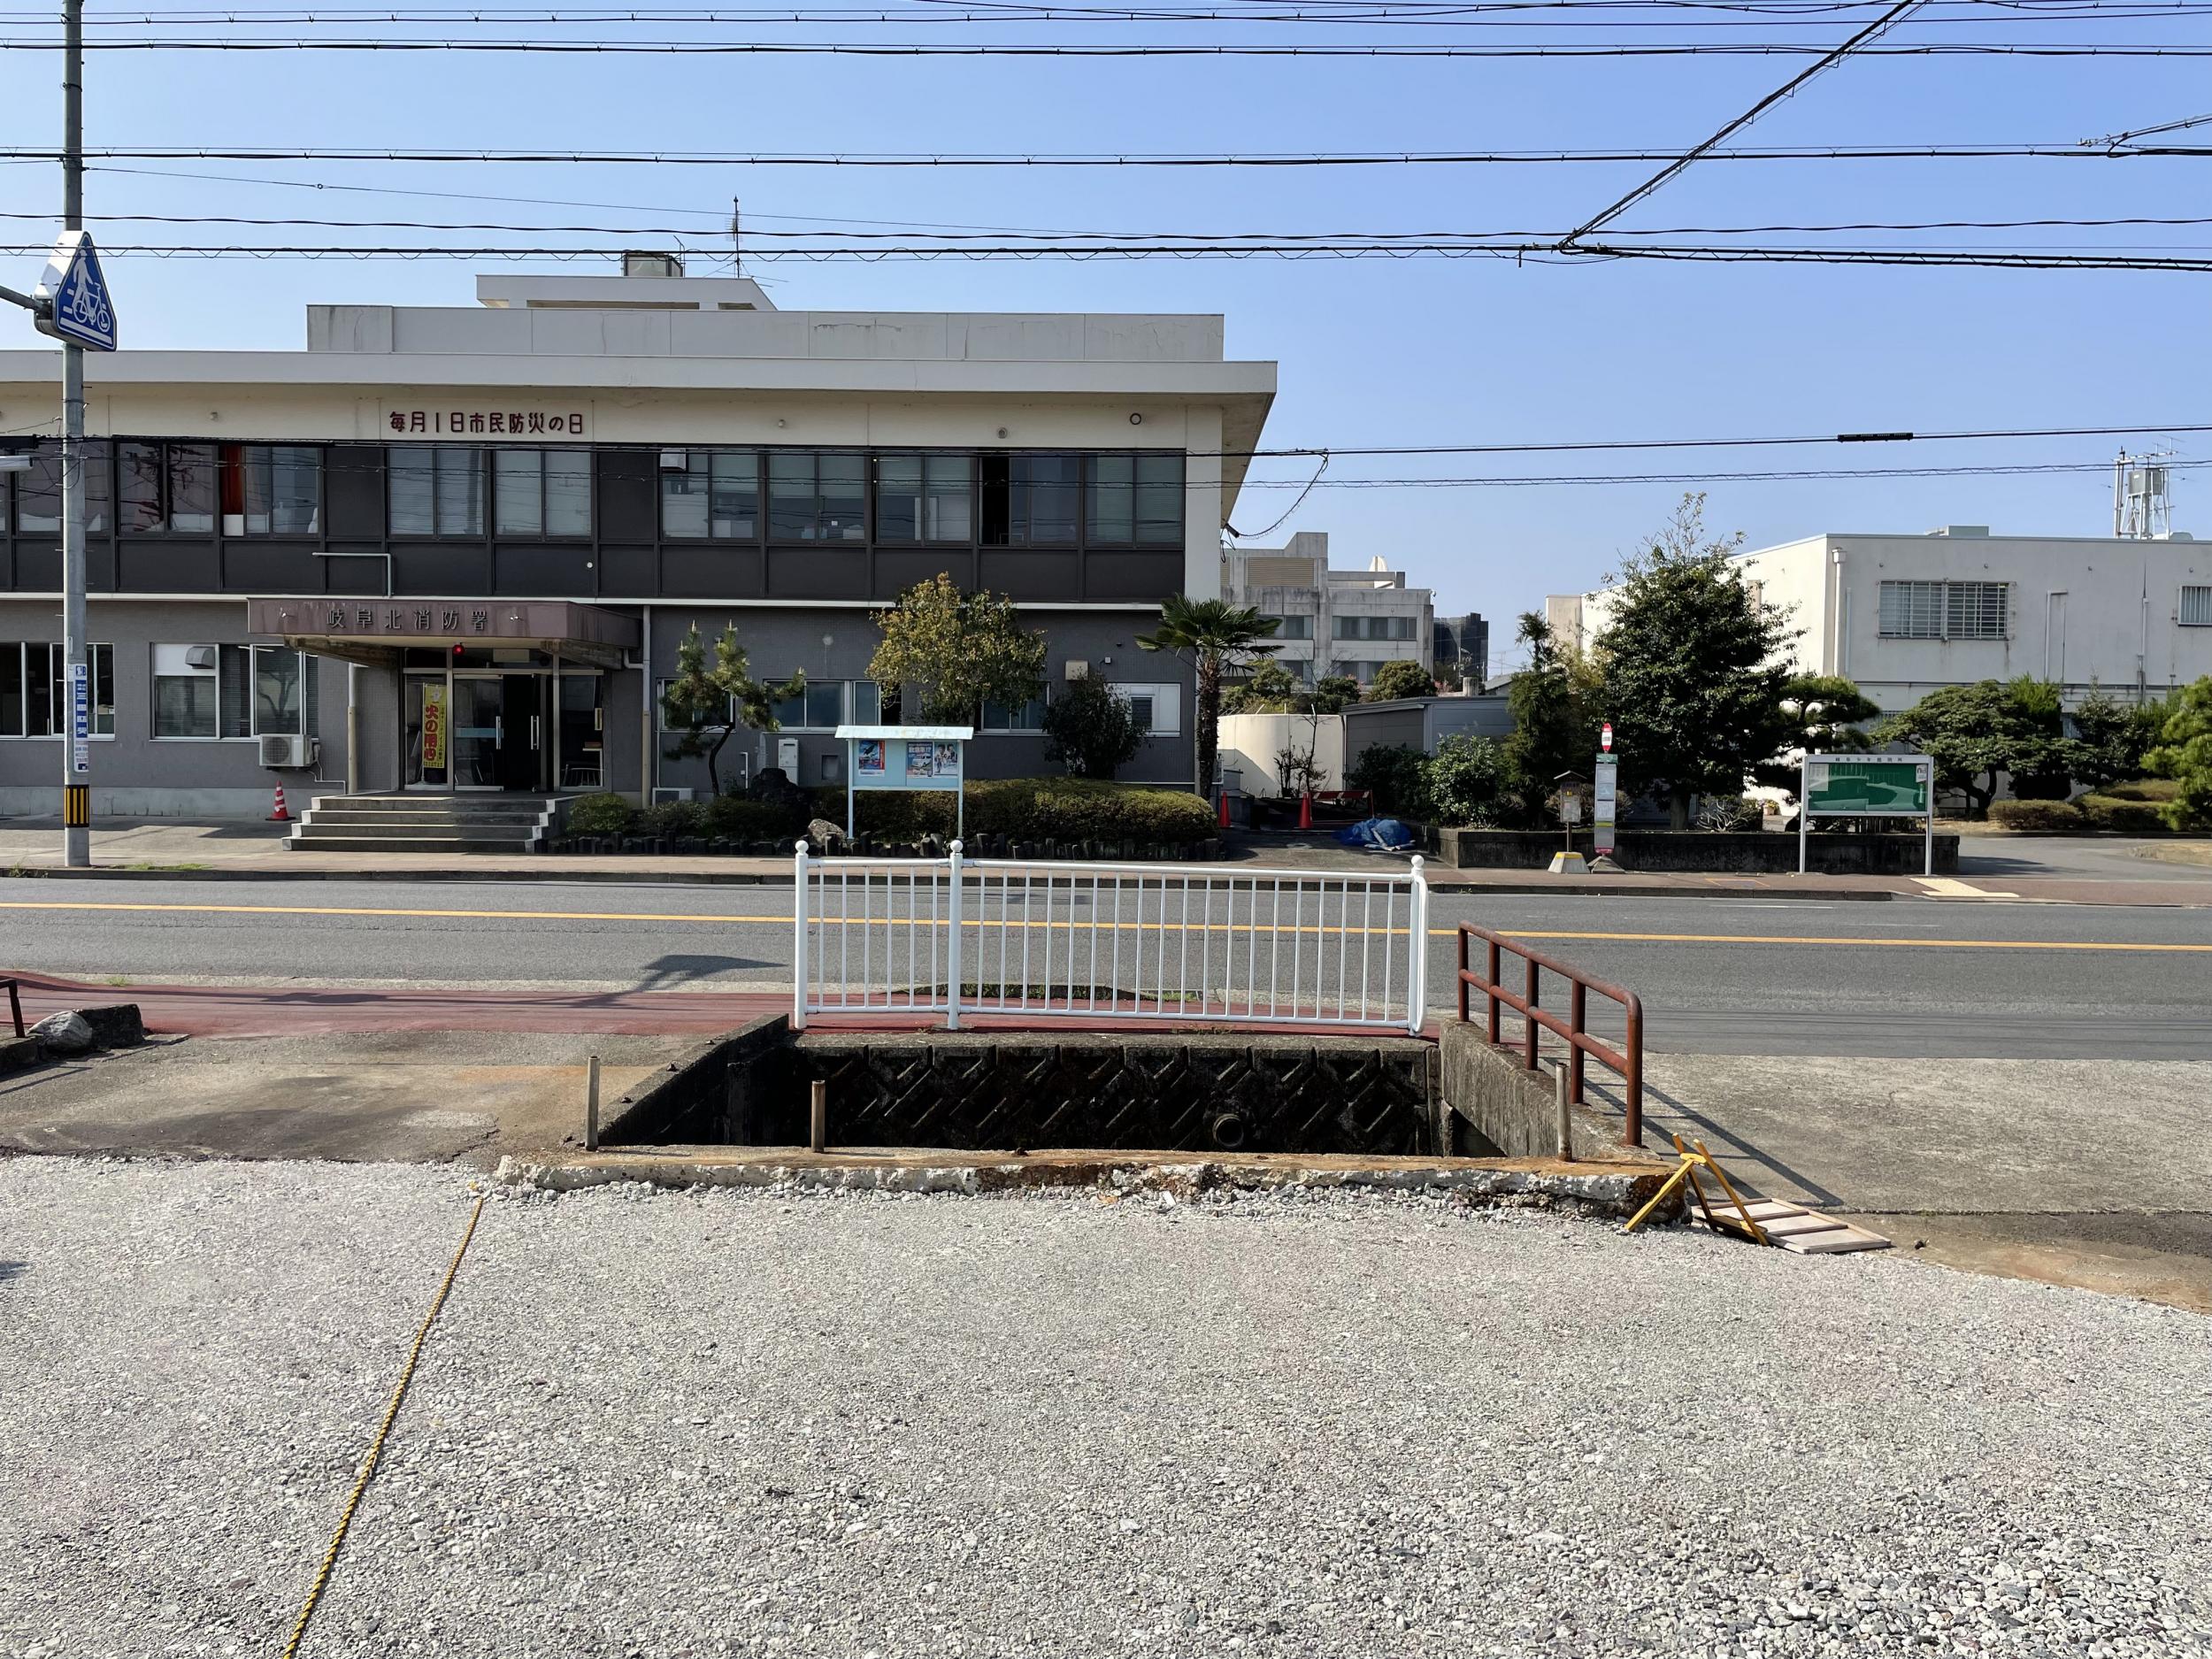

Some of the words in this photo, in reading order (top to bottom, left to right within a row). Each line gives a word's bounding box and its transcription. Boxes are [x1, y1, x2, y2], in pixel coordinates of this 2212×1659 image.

[326, 608, 488, 631] 岐阜北消防署
